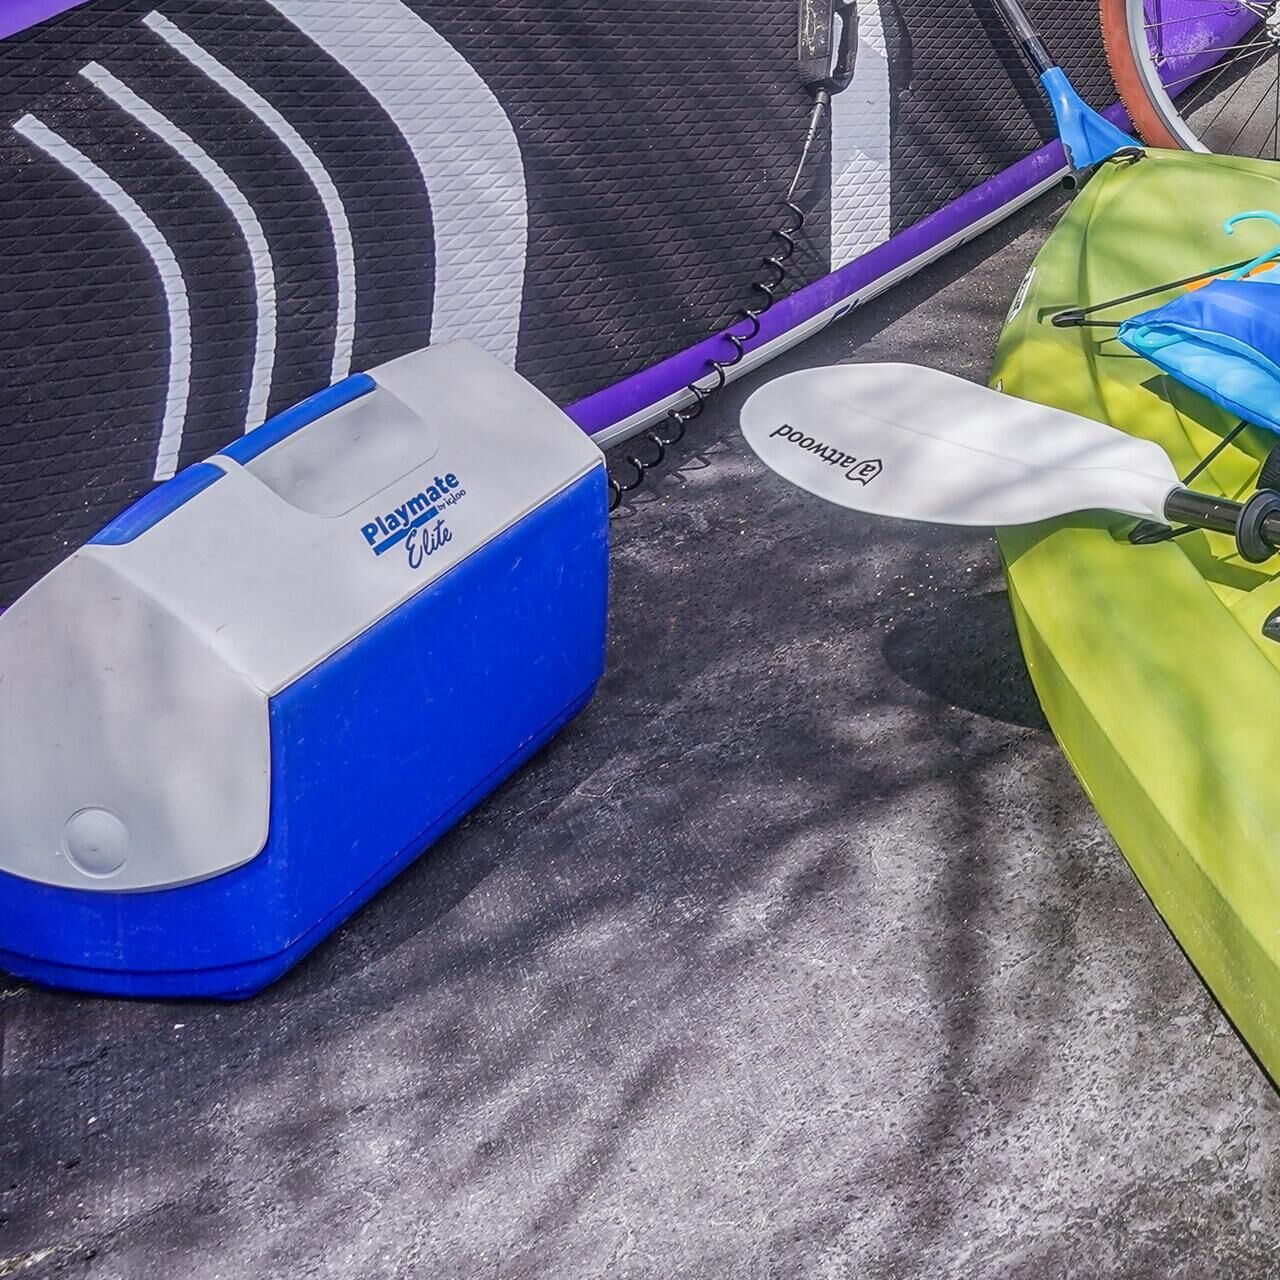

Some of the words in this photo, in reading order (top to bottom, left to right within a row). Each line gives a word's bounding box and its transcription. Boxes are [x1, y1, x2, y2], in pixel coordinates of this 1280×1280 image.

[768, 423, 857, 468] attwood
[360, 472, 460, 546] Playmate
[445, 488, 467, 506] igloo
[405, 519, 453, 570] Elite
